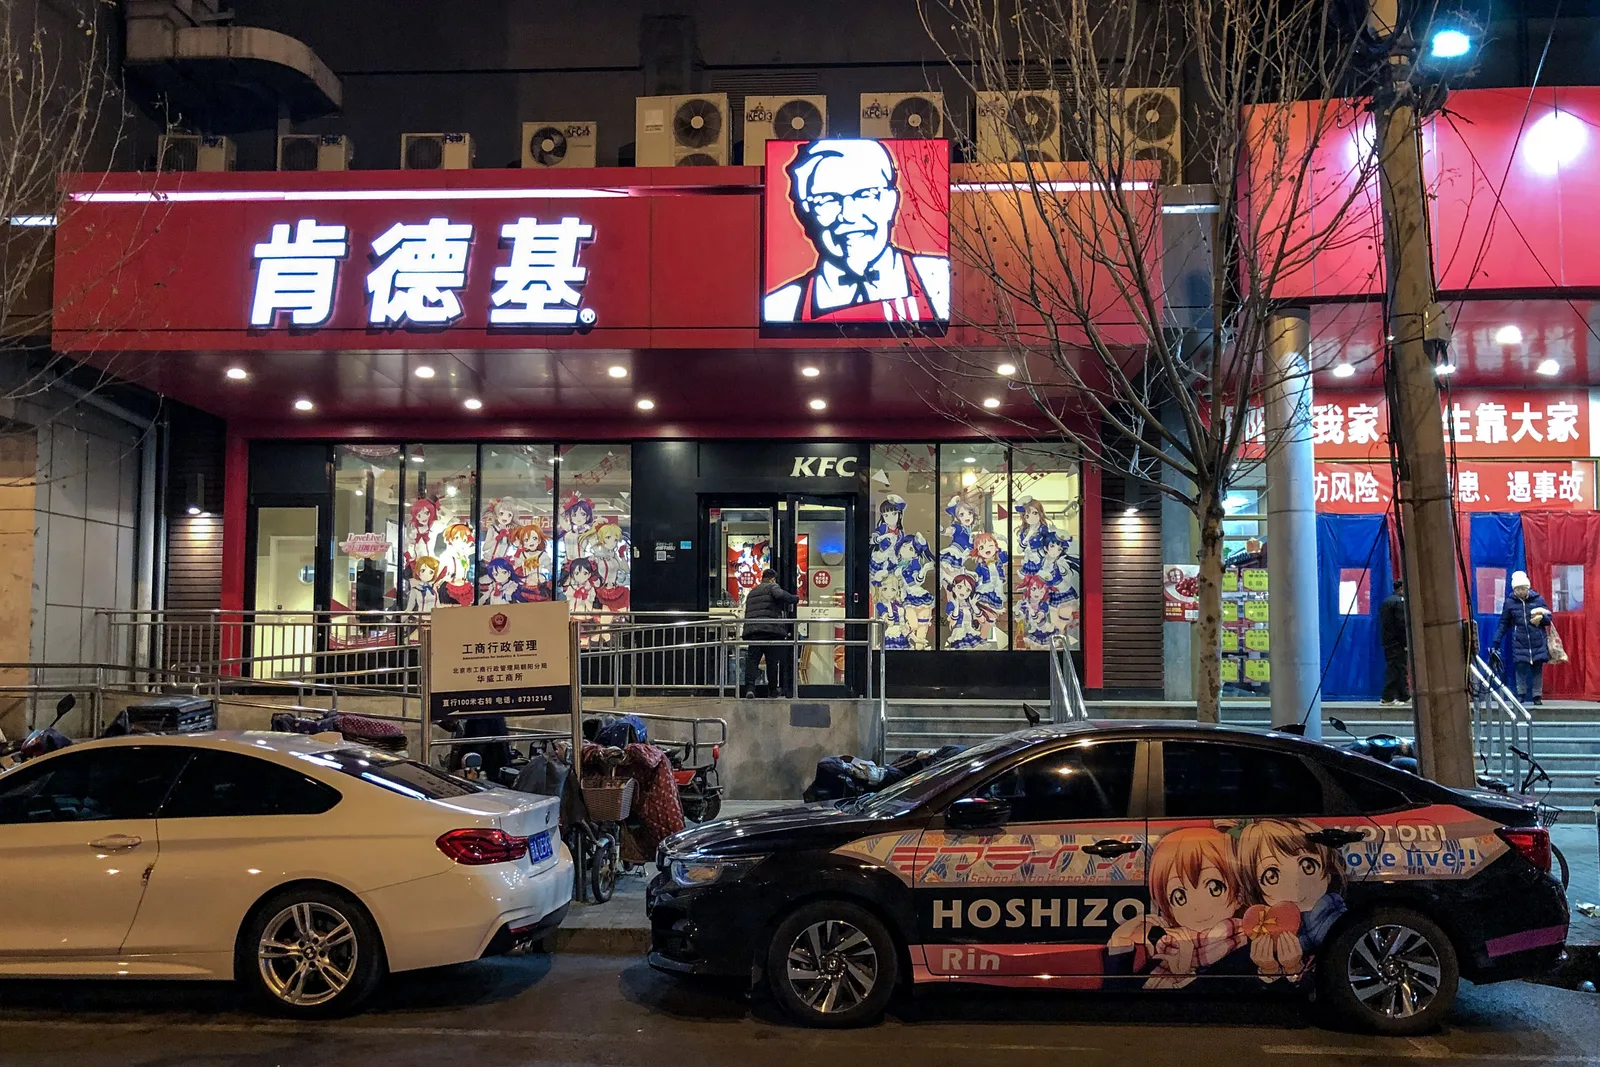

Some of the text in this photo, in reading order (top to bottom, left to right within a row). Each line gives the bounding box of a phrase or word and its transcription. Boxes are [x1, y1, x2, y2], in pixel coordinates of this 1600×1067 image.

[250, 216, 591, 325] 肯德基
[789, 456, 858, 477] KFC
[462, 640, 538, 655] 工商行政管理
[476, 672, 524, 683] 华威工商所
[442, 697, 493, 707] 直行100米右转
[1334, 824, 1448, 843] OTORI
[1346, 850, 1397, 867] ove
[969, 873, 1016, 885] School
[941, 947, 1001, 971] Rin
